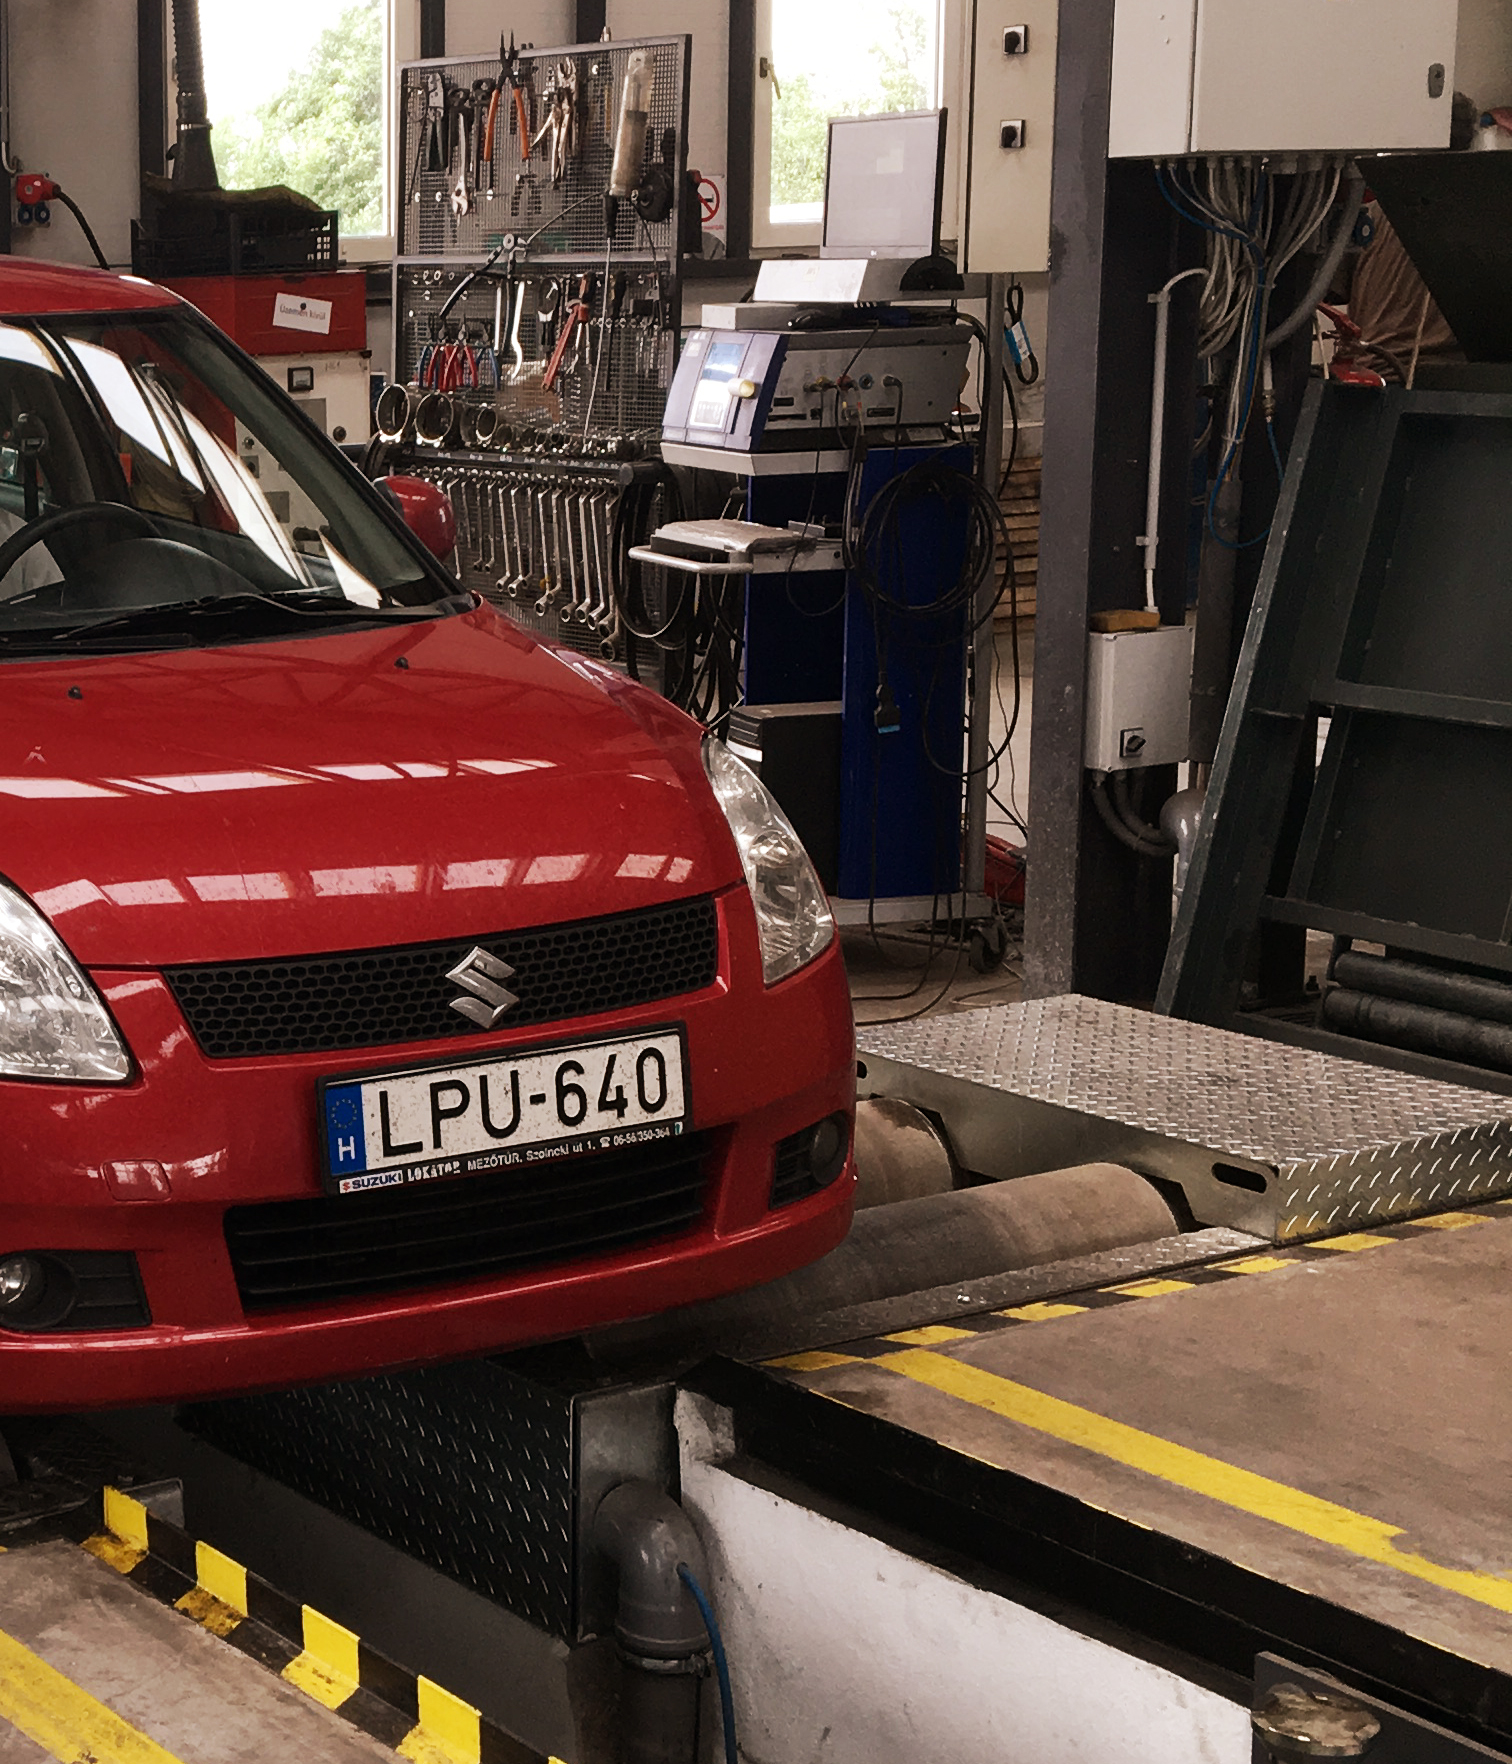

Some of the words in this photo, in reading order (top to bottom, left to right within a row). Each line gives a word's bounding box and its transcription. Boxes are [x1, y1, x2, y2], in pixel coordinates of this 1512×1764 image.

[378, 1046, 669, 1158] LPU-640
[337, 1135, 356, 1162] H
[351, 1171, 402, 1190] SUZUKI
